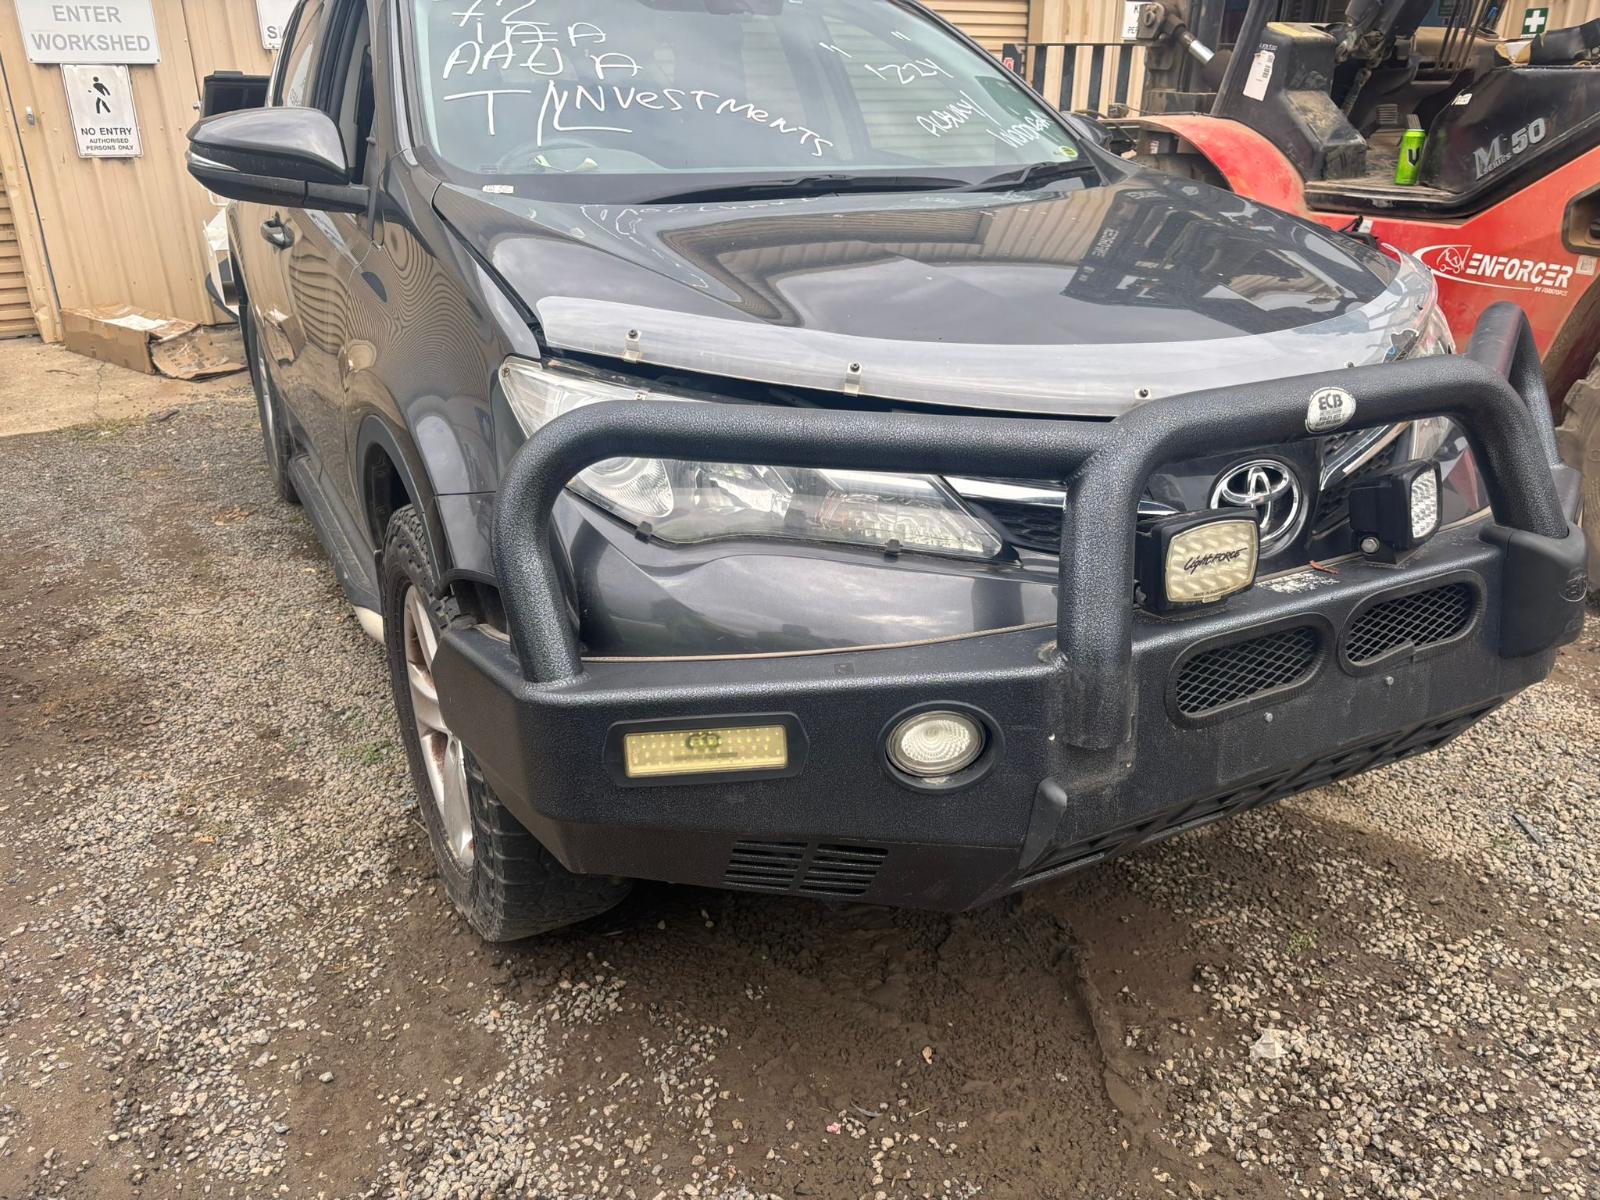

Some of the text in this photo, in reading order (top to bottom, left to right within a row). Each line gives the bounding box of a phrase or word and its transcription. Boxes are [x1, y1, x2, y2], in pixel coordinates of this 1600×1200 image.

[53, 4, 122, 24] ENTER
[31, 33, 151, 52] WORKSHED
[81, 127, 132, 136] NO ENTRY
[1511, 117, 1546, 154] 50
[1465, 252, 1574, 289] ENFORCER
[1318, 392, 1344, 410] ECB
